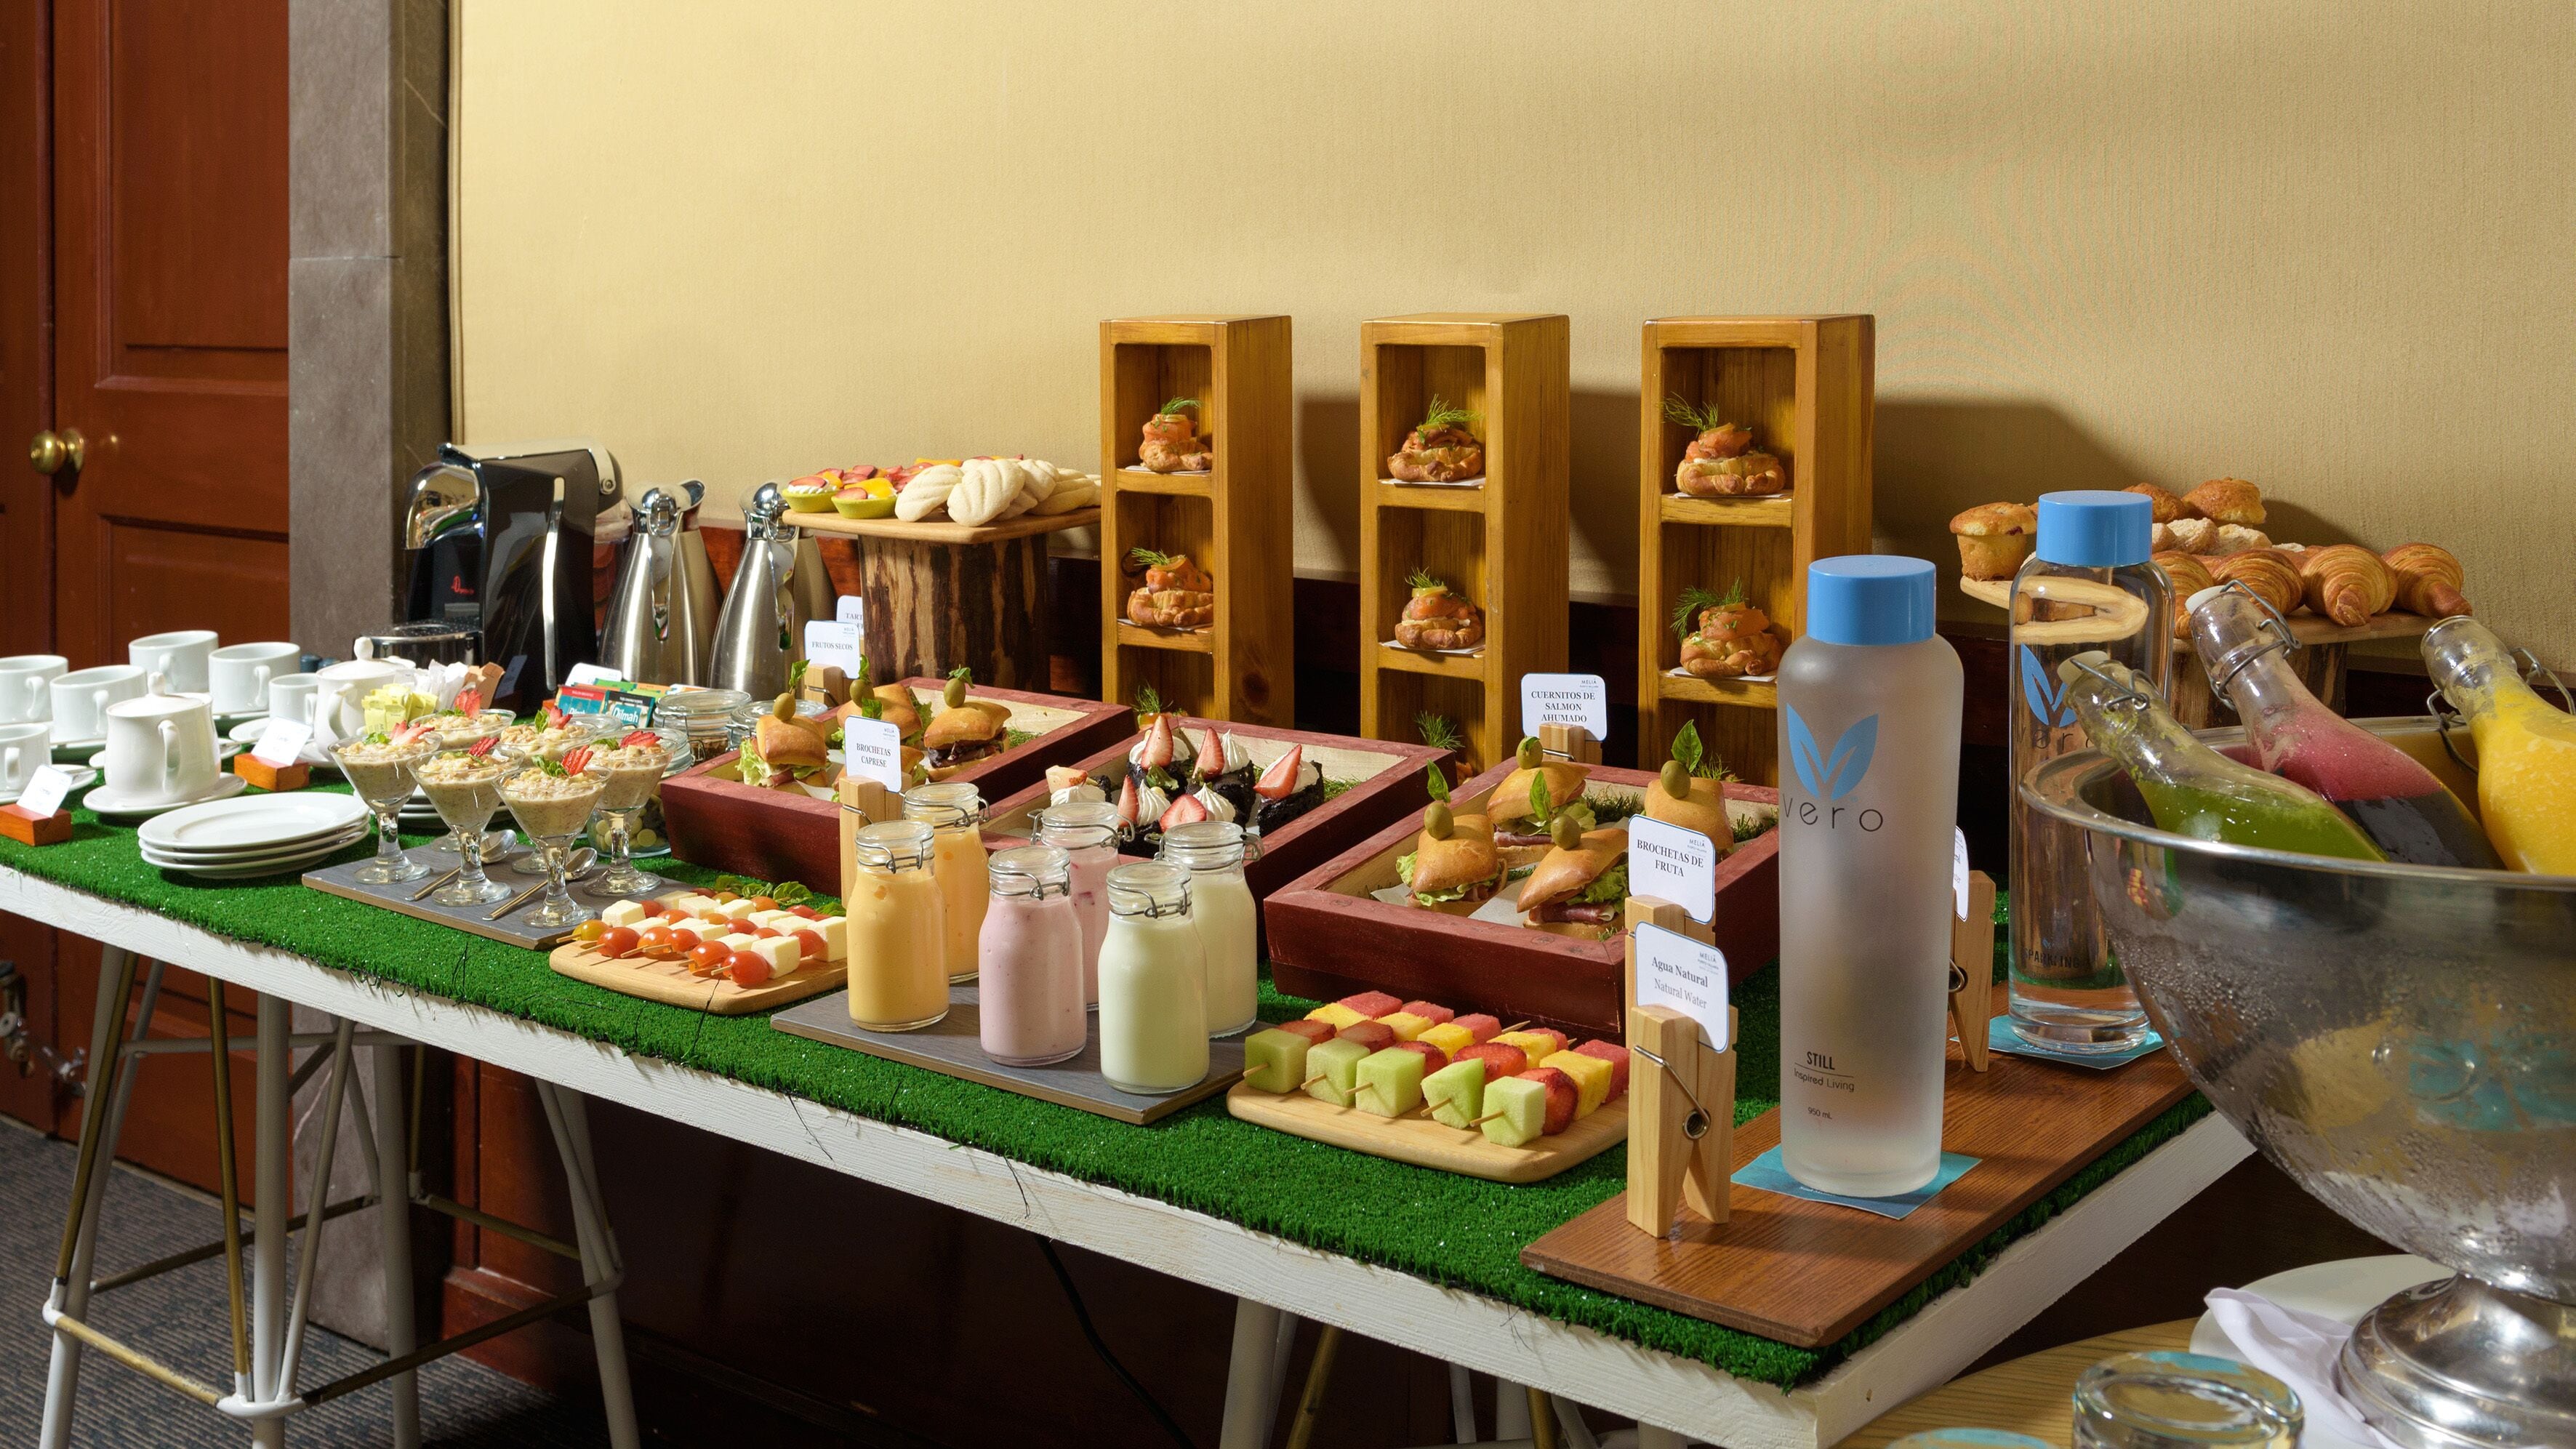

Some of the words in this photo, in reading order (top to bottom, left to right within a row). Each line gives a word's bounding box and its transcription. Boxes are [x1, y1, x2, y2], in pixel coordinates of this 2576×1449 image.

[811, 641, 835, 650] FRUTOS
[1531, 691, 1581, 700] CUERNITOS
[1545, 702, 1582, 711] SALMON
[612, 707, 638, 723] Dilmah
[1541, 714, 1587, 723] AHUMADO
[856, 743, 891, 757] BROCHETAS
[861, 756, 887, 768] CAPRESE
[1782, 793, 1883, 832] vero
[1637, 839, 1690, 864] BROCHETAS
[1691, 856, 1704, 868] DE
[1655, 859, 1685, 877] FRUTA
[1652, 957, 1673, 974] Agua
[1675, 965, 1709, 988] Natural
[1654, 978, 1683, 999] Natural
[1684, 990, 1707, 1009] Water
[1806, 1051, 1836, 1070] STILL
[1794, 1068, 1823, 1086] Inspired
[1826, 1078, 1855, 1093] Living
[1807, 1107, 1821, 1117] 950
[1822, 1111, 1833, 1120] mL
